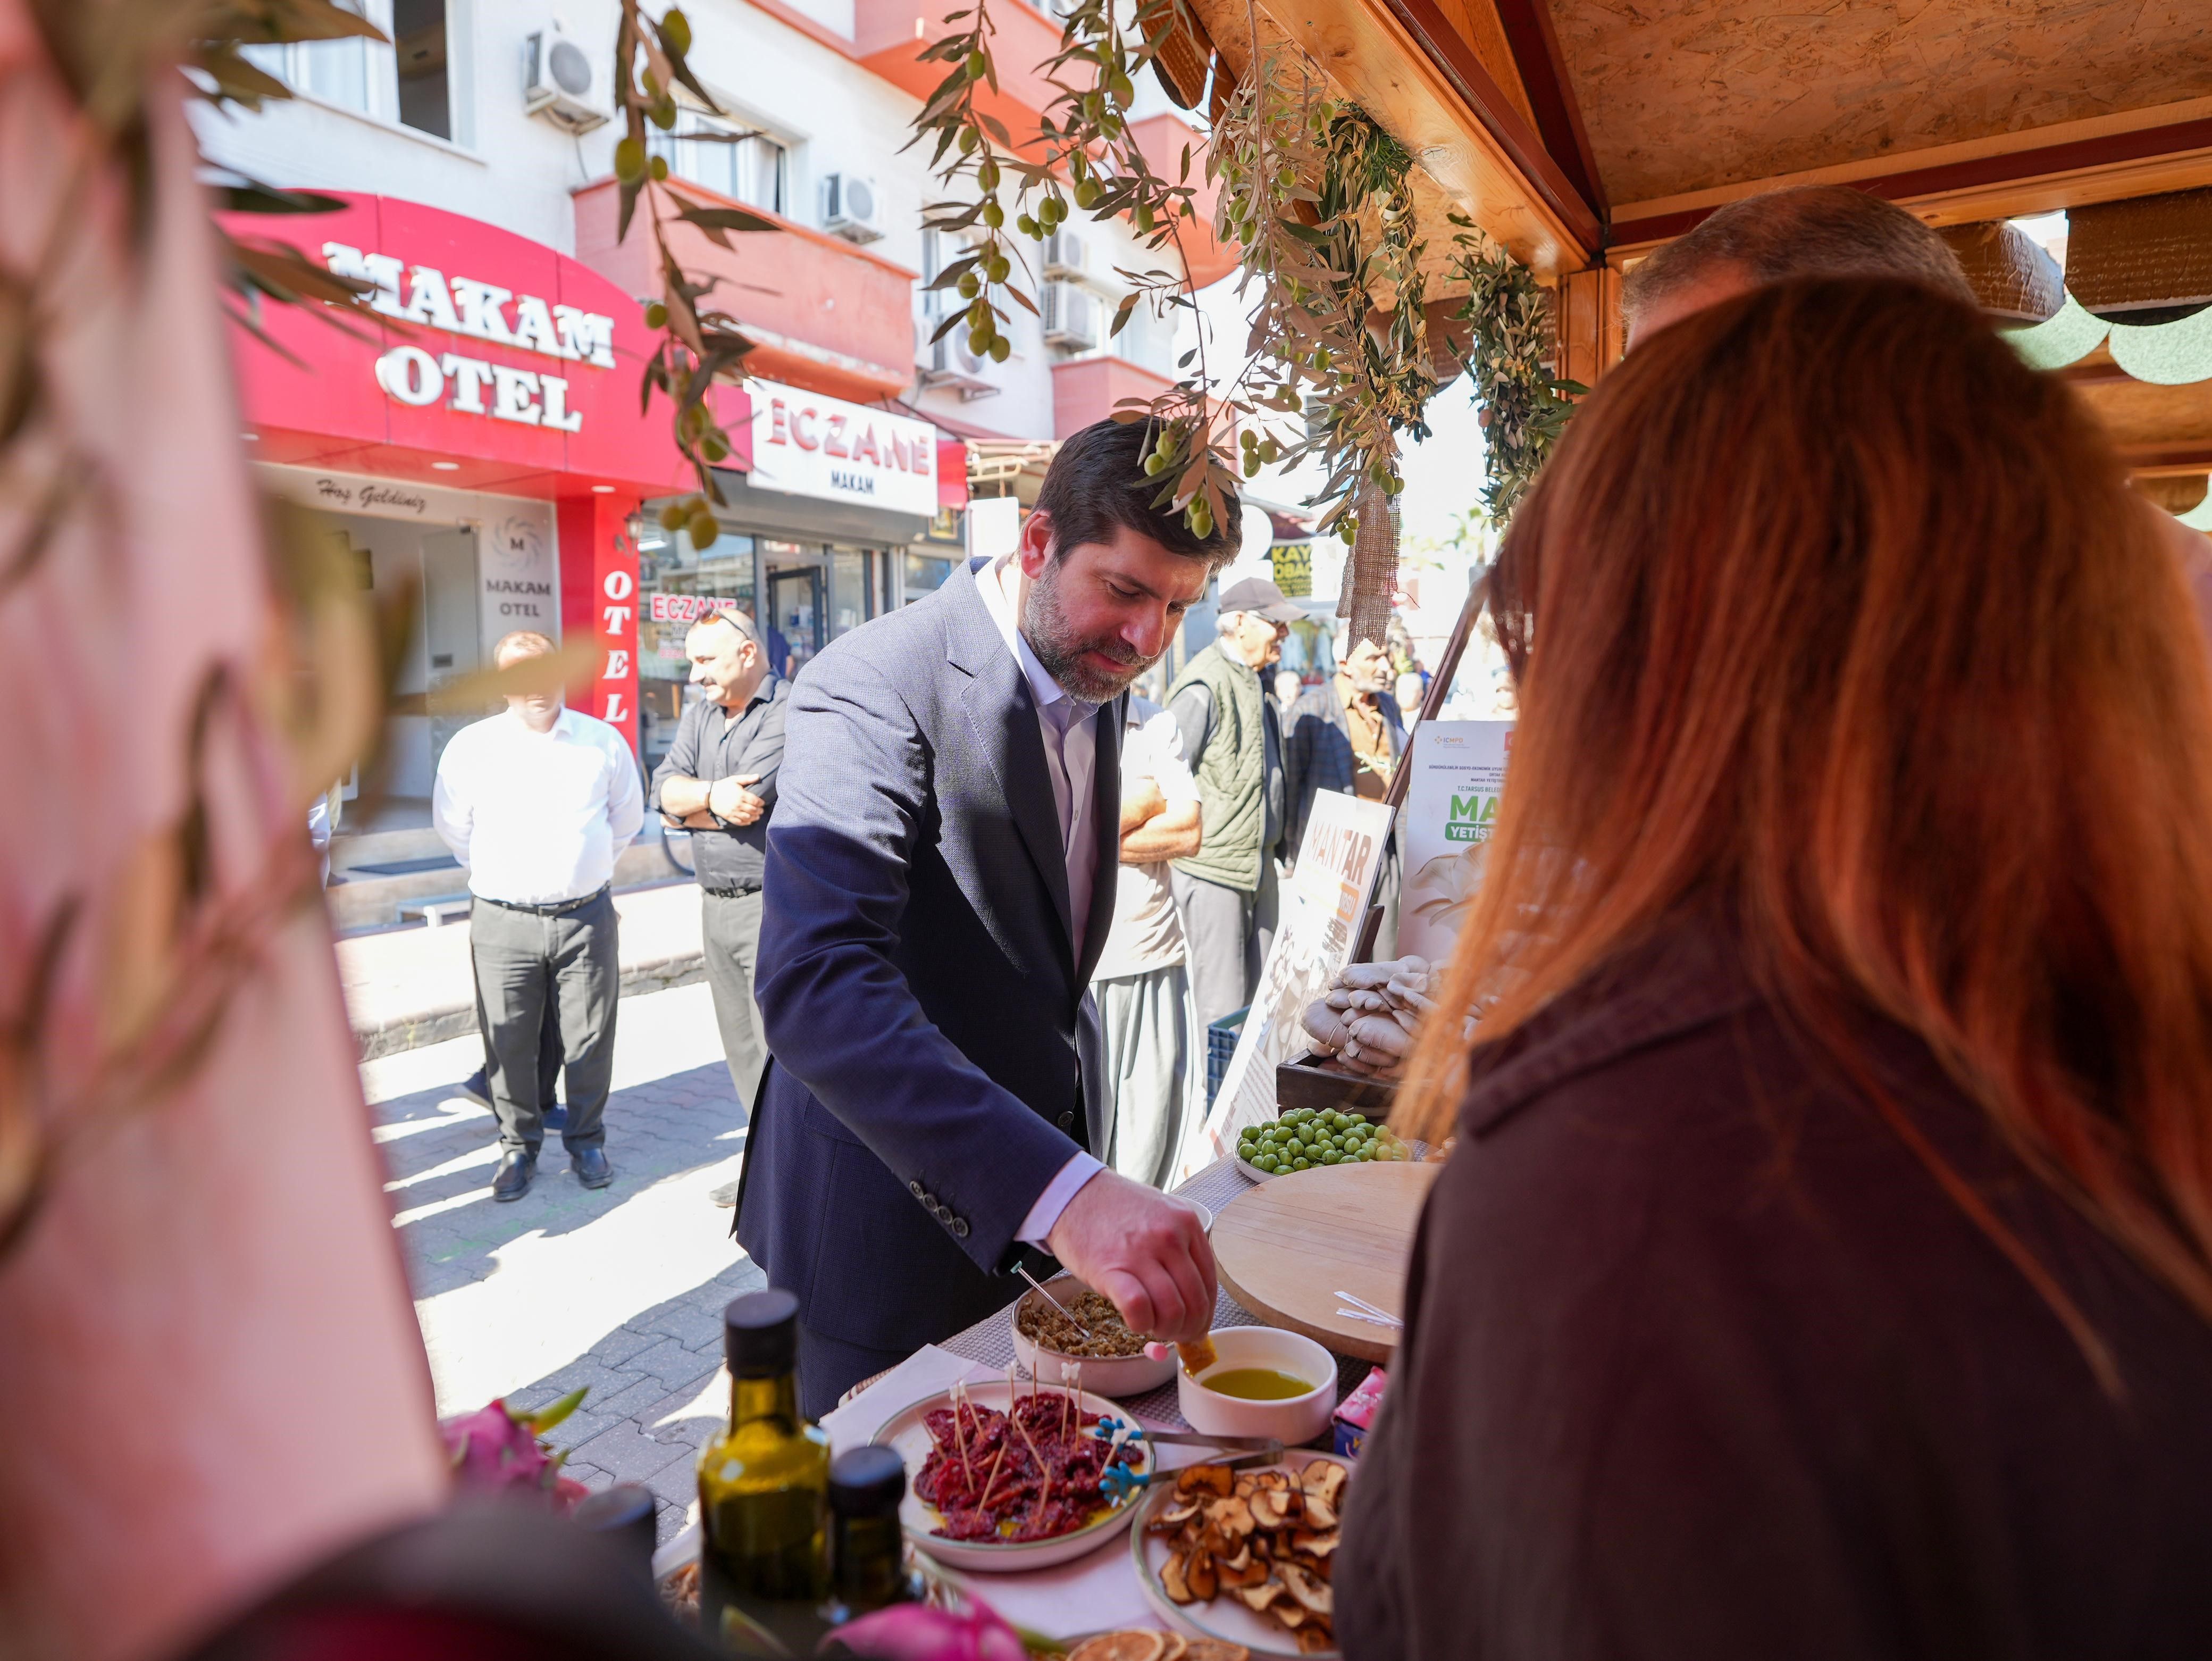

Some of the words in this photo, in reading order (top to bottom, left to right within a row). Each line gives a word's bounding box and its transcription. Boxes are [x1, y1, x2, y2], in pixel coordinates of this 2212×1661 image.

[322, 241, 616, 369] MAKAM
[375, 345, 583, 432] OTEL
[765, 398, 929, 475] ECZANE
[831, 470, 874, 495] MAKAM
[359, 485, 426, 514] Geldiniz
[510, 537, 524, 551] M
[1271, 545, 1312, 564] KAY
[486, 579, 551, 596] MAKAM
[500, 603, 540, 617] OTEL
[602, 571, 633, 723] OTEL
[1450, 795, 1499, 822] MA
[1451, 825, 1495, 842] YETİŞT
[1307, 821, 1372, 886] MANTAR
